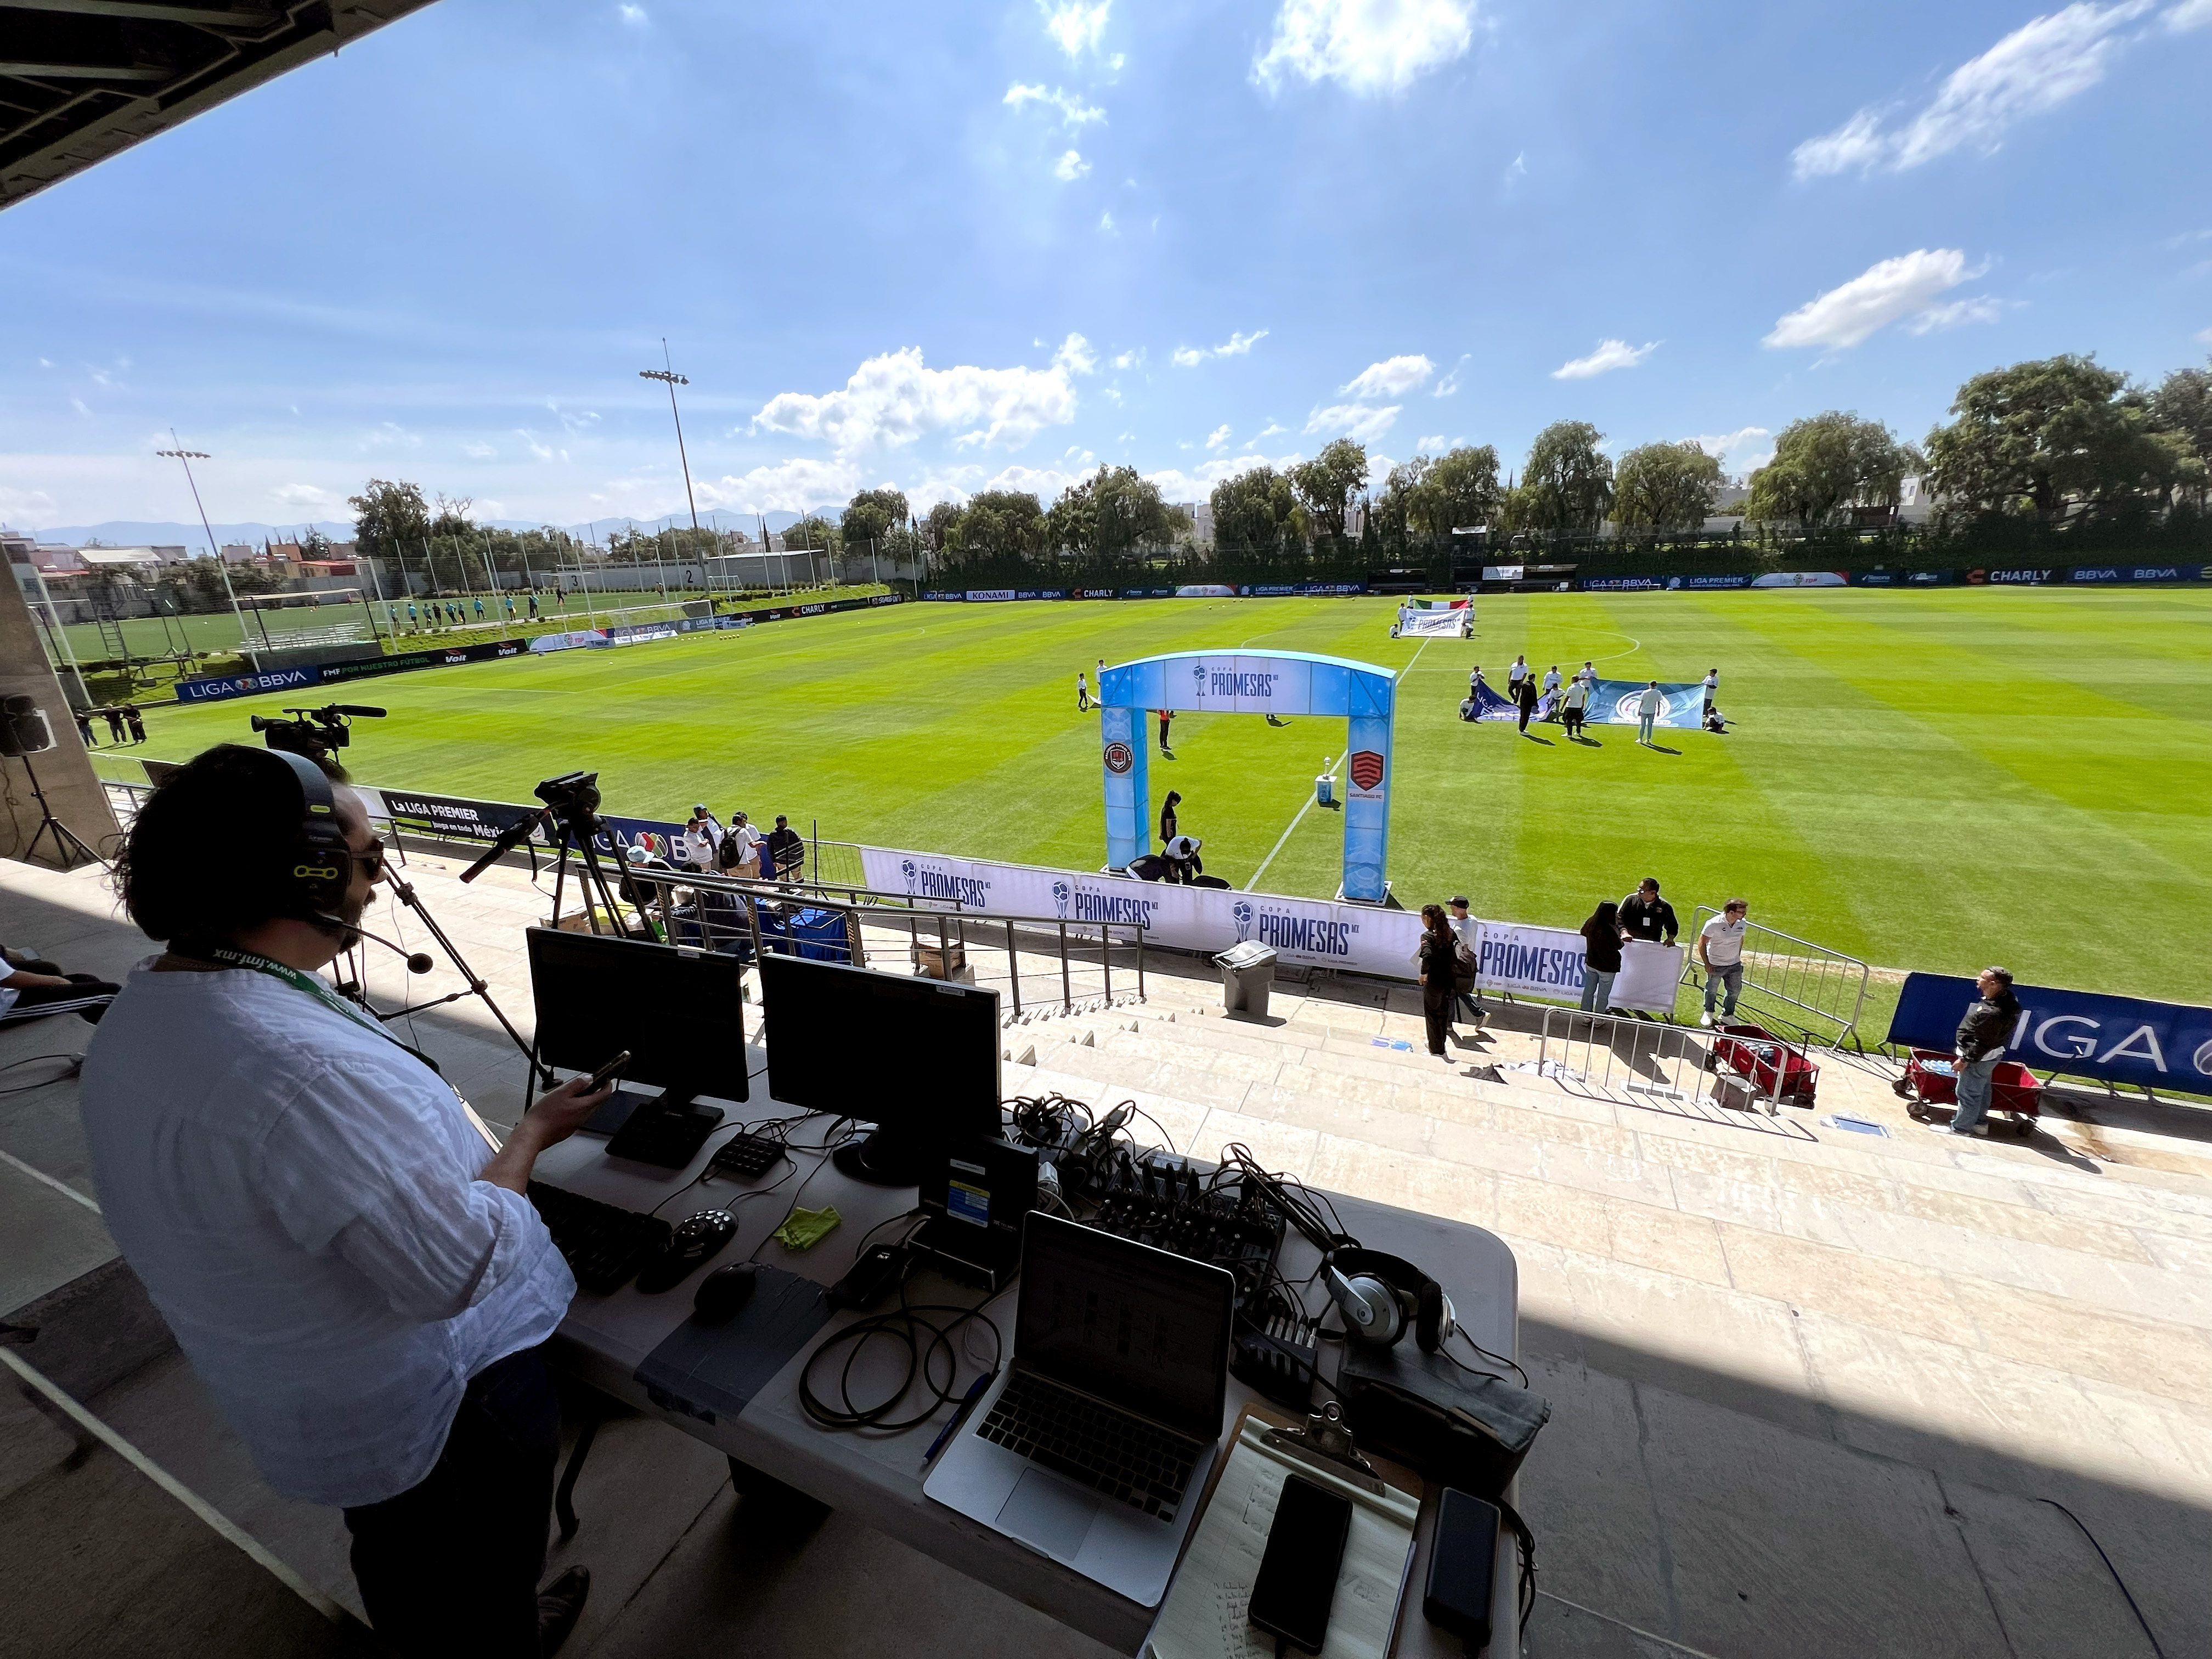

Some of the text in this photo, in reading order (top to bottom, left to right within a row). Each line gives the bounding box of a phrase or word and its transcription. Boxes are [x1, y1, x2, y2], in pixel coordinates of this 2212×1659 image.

[686, 570, 693, 583] 2
[1990, 569, 2051, 582] CHARLY
[2074, 568, 2118, 580] BBVA
[2135, 568, 2177, 579] BBVA
[1583, 578, 1652, 588] LIGA BBVA
[972, 591, 1009, 600] KONAMI
[1084, 589, 1113, 597] CHARLY
[802, 603, 825, 614] CHARLY
[647, 624, 671, 634] BBVA
[323, 657, 431, 677] FMF POR NUESTRO FÚTBOL
[189, 670, 307, 698] LIGA BBVA
[1211, 673, 1272, 697] PROMESAS
[391, 800, 479, 821] La LIGA PREMIER
[921, 871, 985, 908] PROMESAS
[1075, 884, 1101, 893] COPA
[1075, 893, 1150, 930] PROMESAS
[1260, 905, 1290, 914] COPA
[1259, 913, 1359, 956] PROMESAS MX
[1483, 931, 1519, 941] COPA
[212, 948, 297, 980] www.fmf.mx
[1479, 940, 1587, 988] PROMESAS
[2010, 1009, 2169, 1073] IGA
